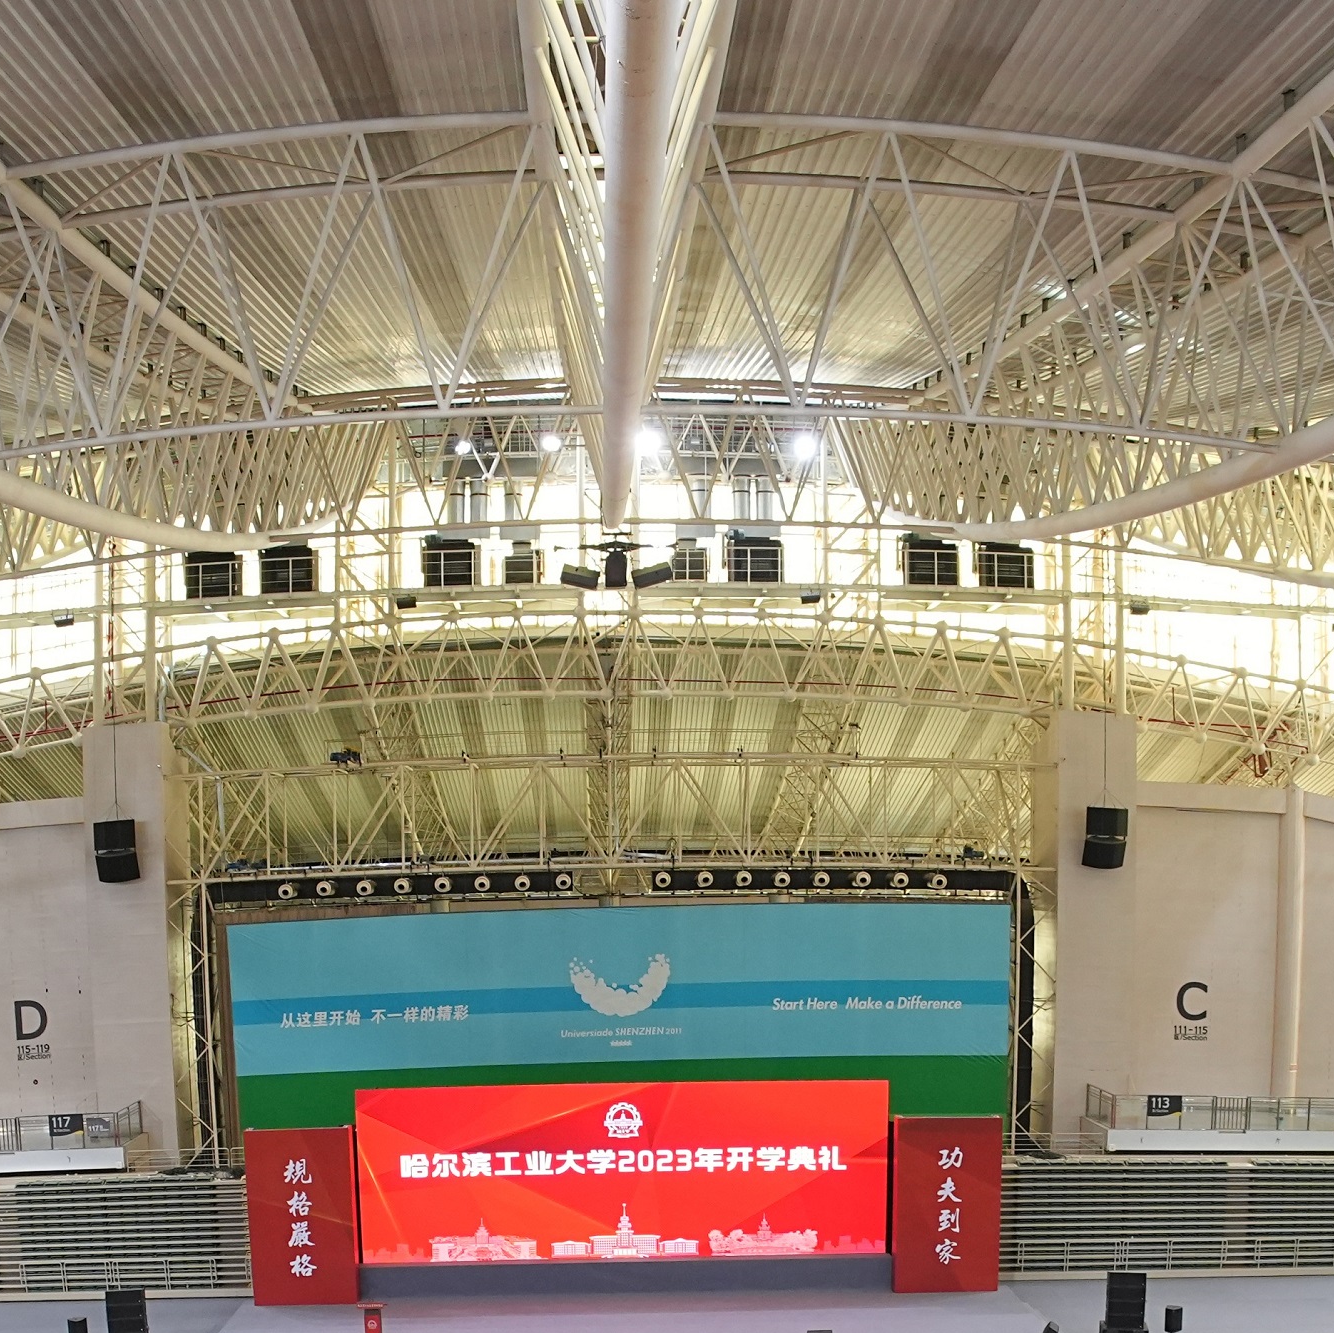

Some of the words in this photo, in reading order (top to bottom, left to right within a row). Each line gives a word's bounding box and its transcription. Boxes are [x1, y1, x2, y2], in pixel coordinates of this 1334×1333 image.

[772, 997, 804, 1011] Start
[806, 997, 838, 1010] Here
[845, 996, 881, 1010] Make
[885, 1000, 894, 1010] a
[897, 995, 962, 1010] Difference
[1177, 981, 1208, 1021] C
[14, 1000, 47, 1040] D
[280, 1009, 361, 1029] 从这里开始
[371, 1004, 469, 1024] 不一样的精彩
[560, 1028, 613, 1038] Universiade
[615, 1026, 665, 1036] SHENZHEN
[665, 1027, 682, 1035] 2011
[1174, 1025, 1208, 1035] 111-115
[17, 1043, 50, 1054] 115-119
[1151, 1097, 1170, 1109] 113
[51, 1116, 71, 1128] 117
[399, 1145, 848, 1179] 哈尔滨工业大学2023年开学典礼
[935, 1146, 964, 1265] 功夫到家
